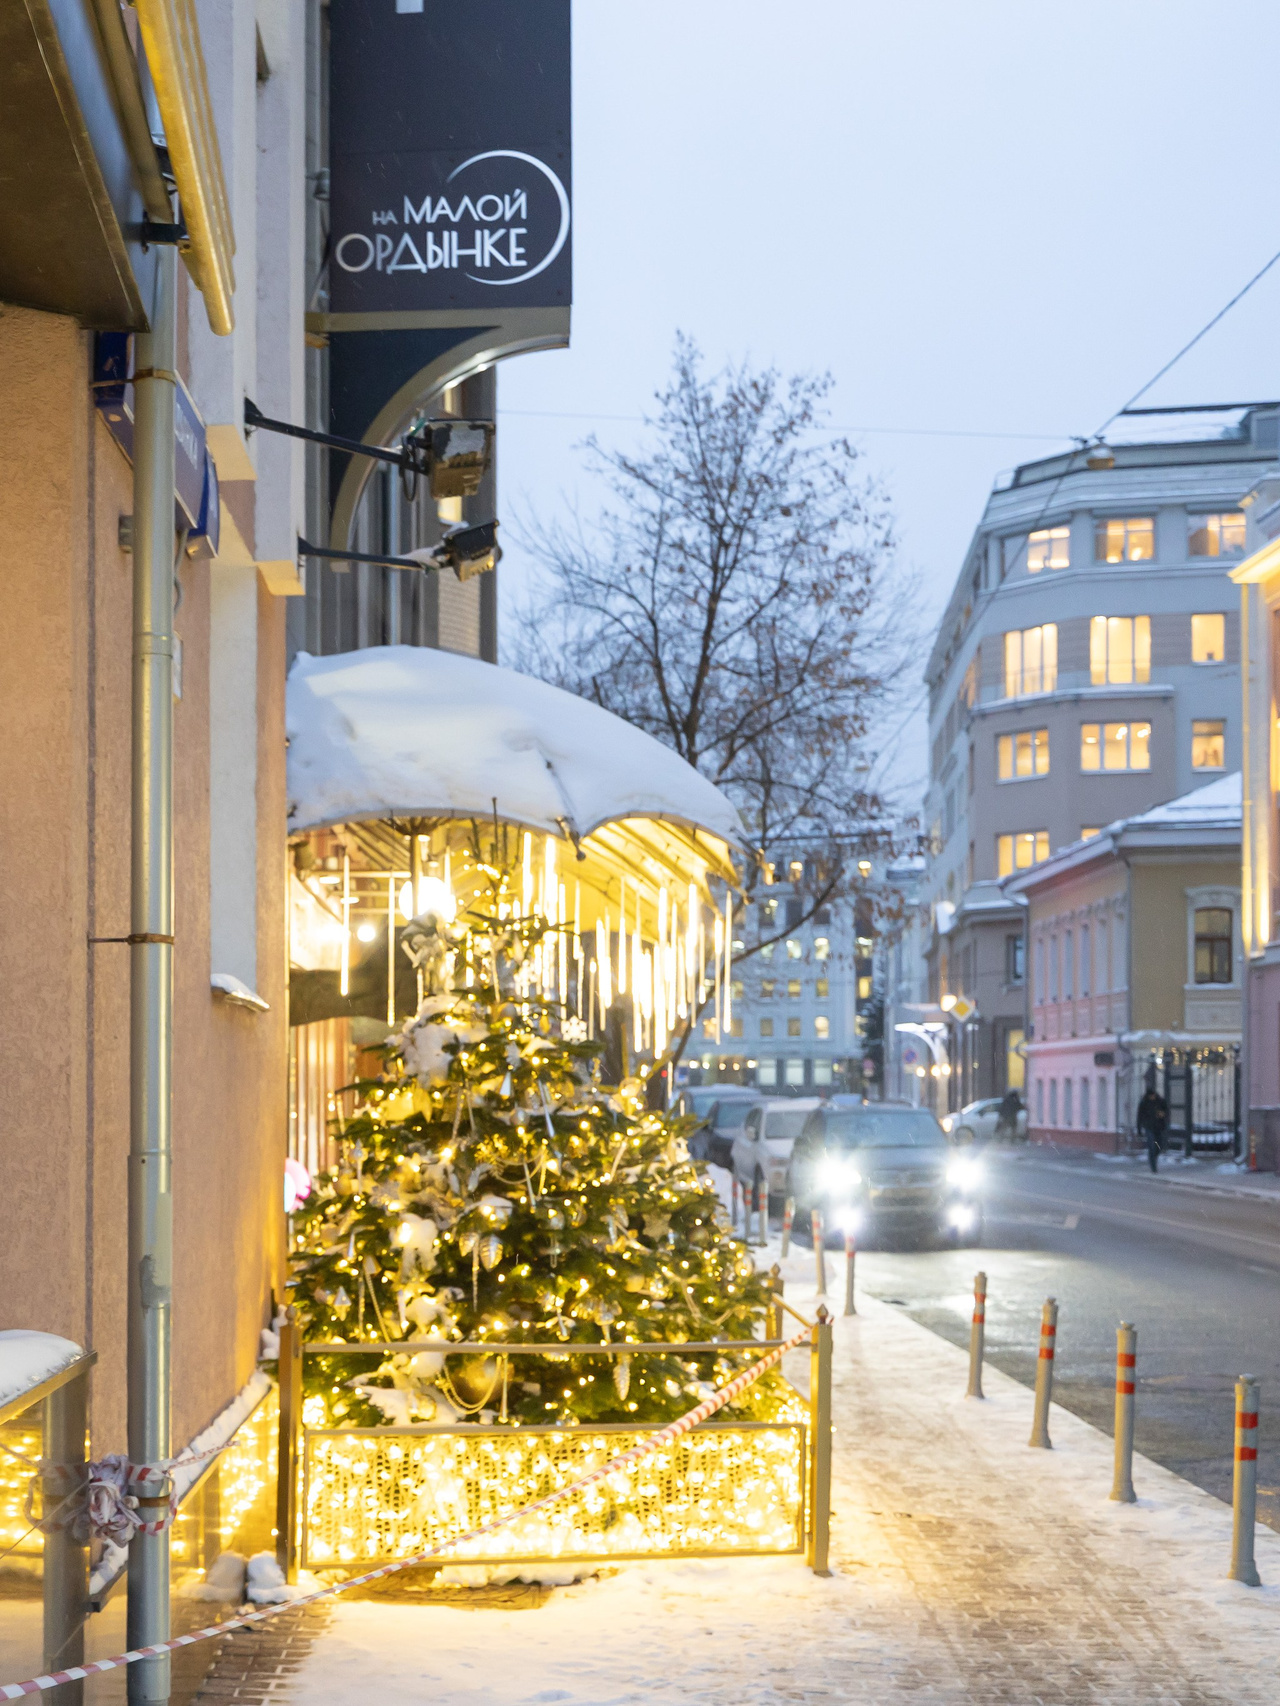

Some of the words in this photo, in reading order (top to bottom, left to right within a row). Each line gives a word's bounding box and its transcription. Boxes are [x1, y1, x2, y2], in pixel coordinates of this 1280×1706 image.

[373, 210, 398, 225] НА
[404, 188, 527, 224] МАЛОЙ
[335, 228, 527, 275] ОРДЫНКЕ
